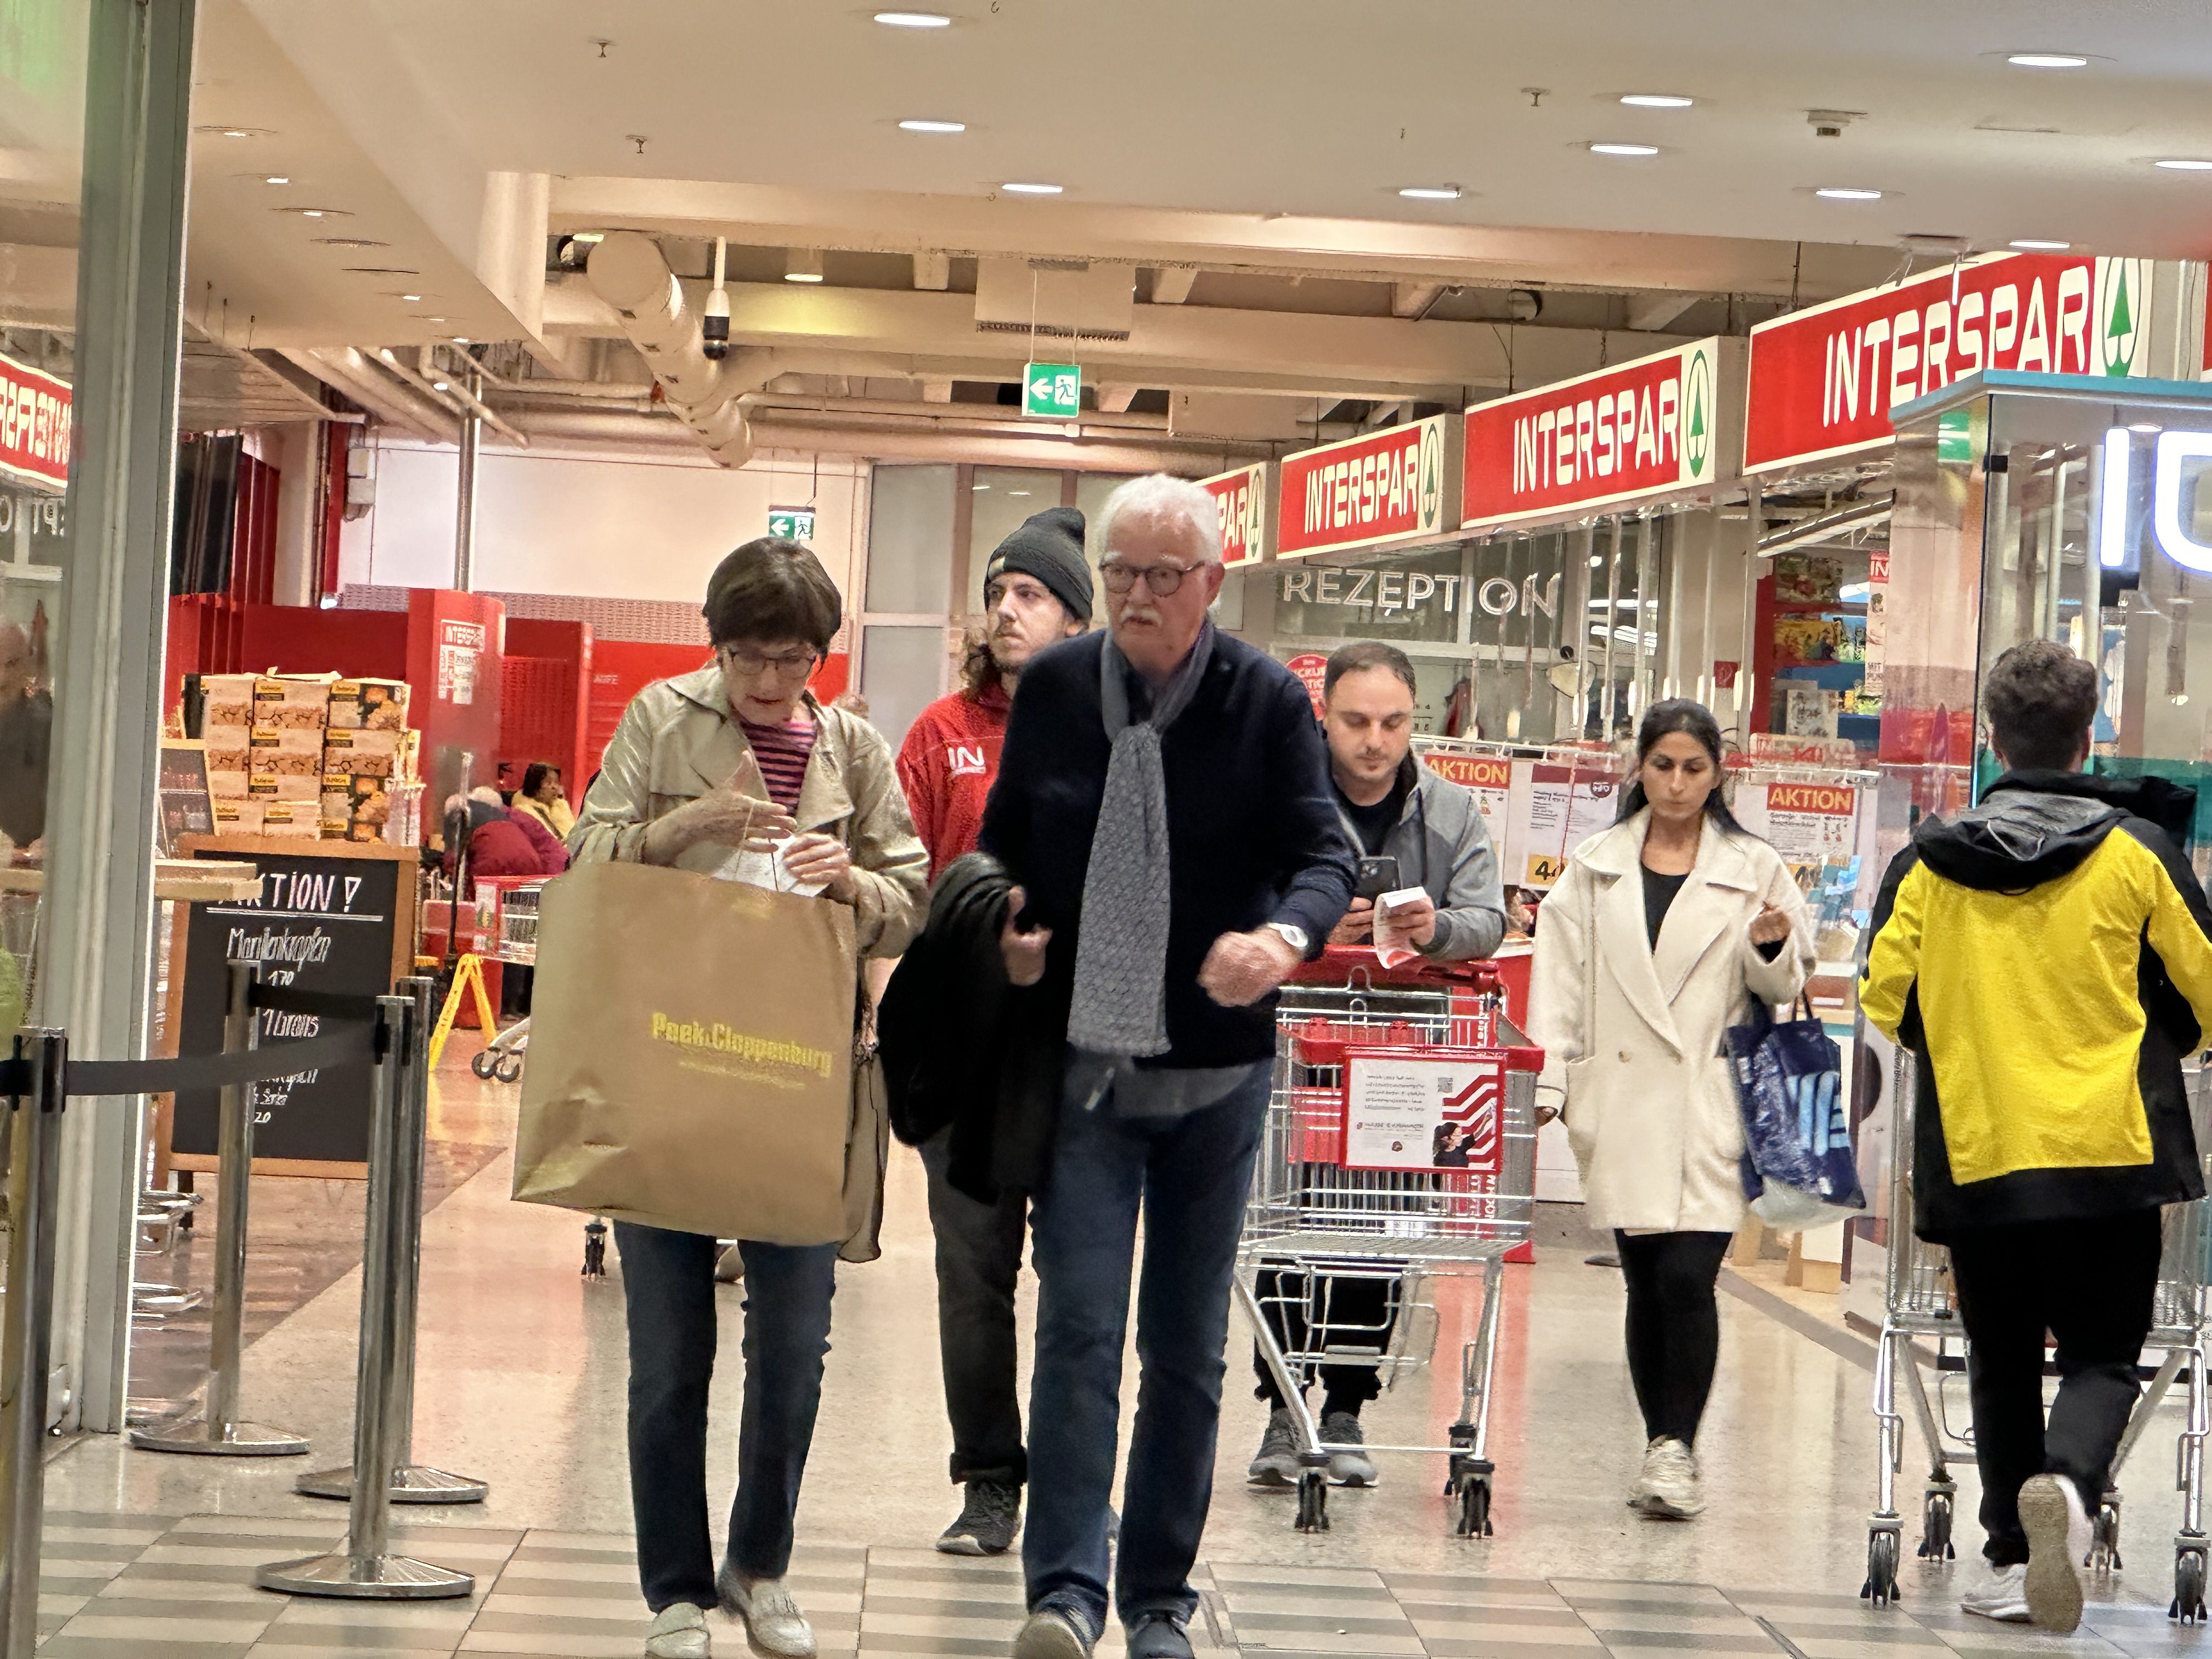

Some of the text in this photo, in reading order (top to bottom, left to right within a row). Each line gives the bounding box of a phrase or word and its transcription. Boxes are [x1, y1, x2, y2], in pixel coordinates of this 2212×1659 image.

[1823, 266, 2089, 427] INTERSPAR
[1513, 377, 1678, 495] INTERSPAR
[1304, 443, 1419, 534] INTERSPAR
[1283, 568, 1561, 618] REZEPTION
[947, 746, 985, 770] IN
[1429, 759, 1508, 785] AKTION
[1769, 787, 1852, 810] AKTION
